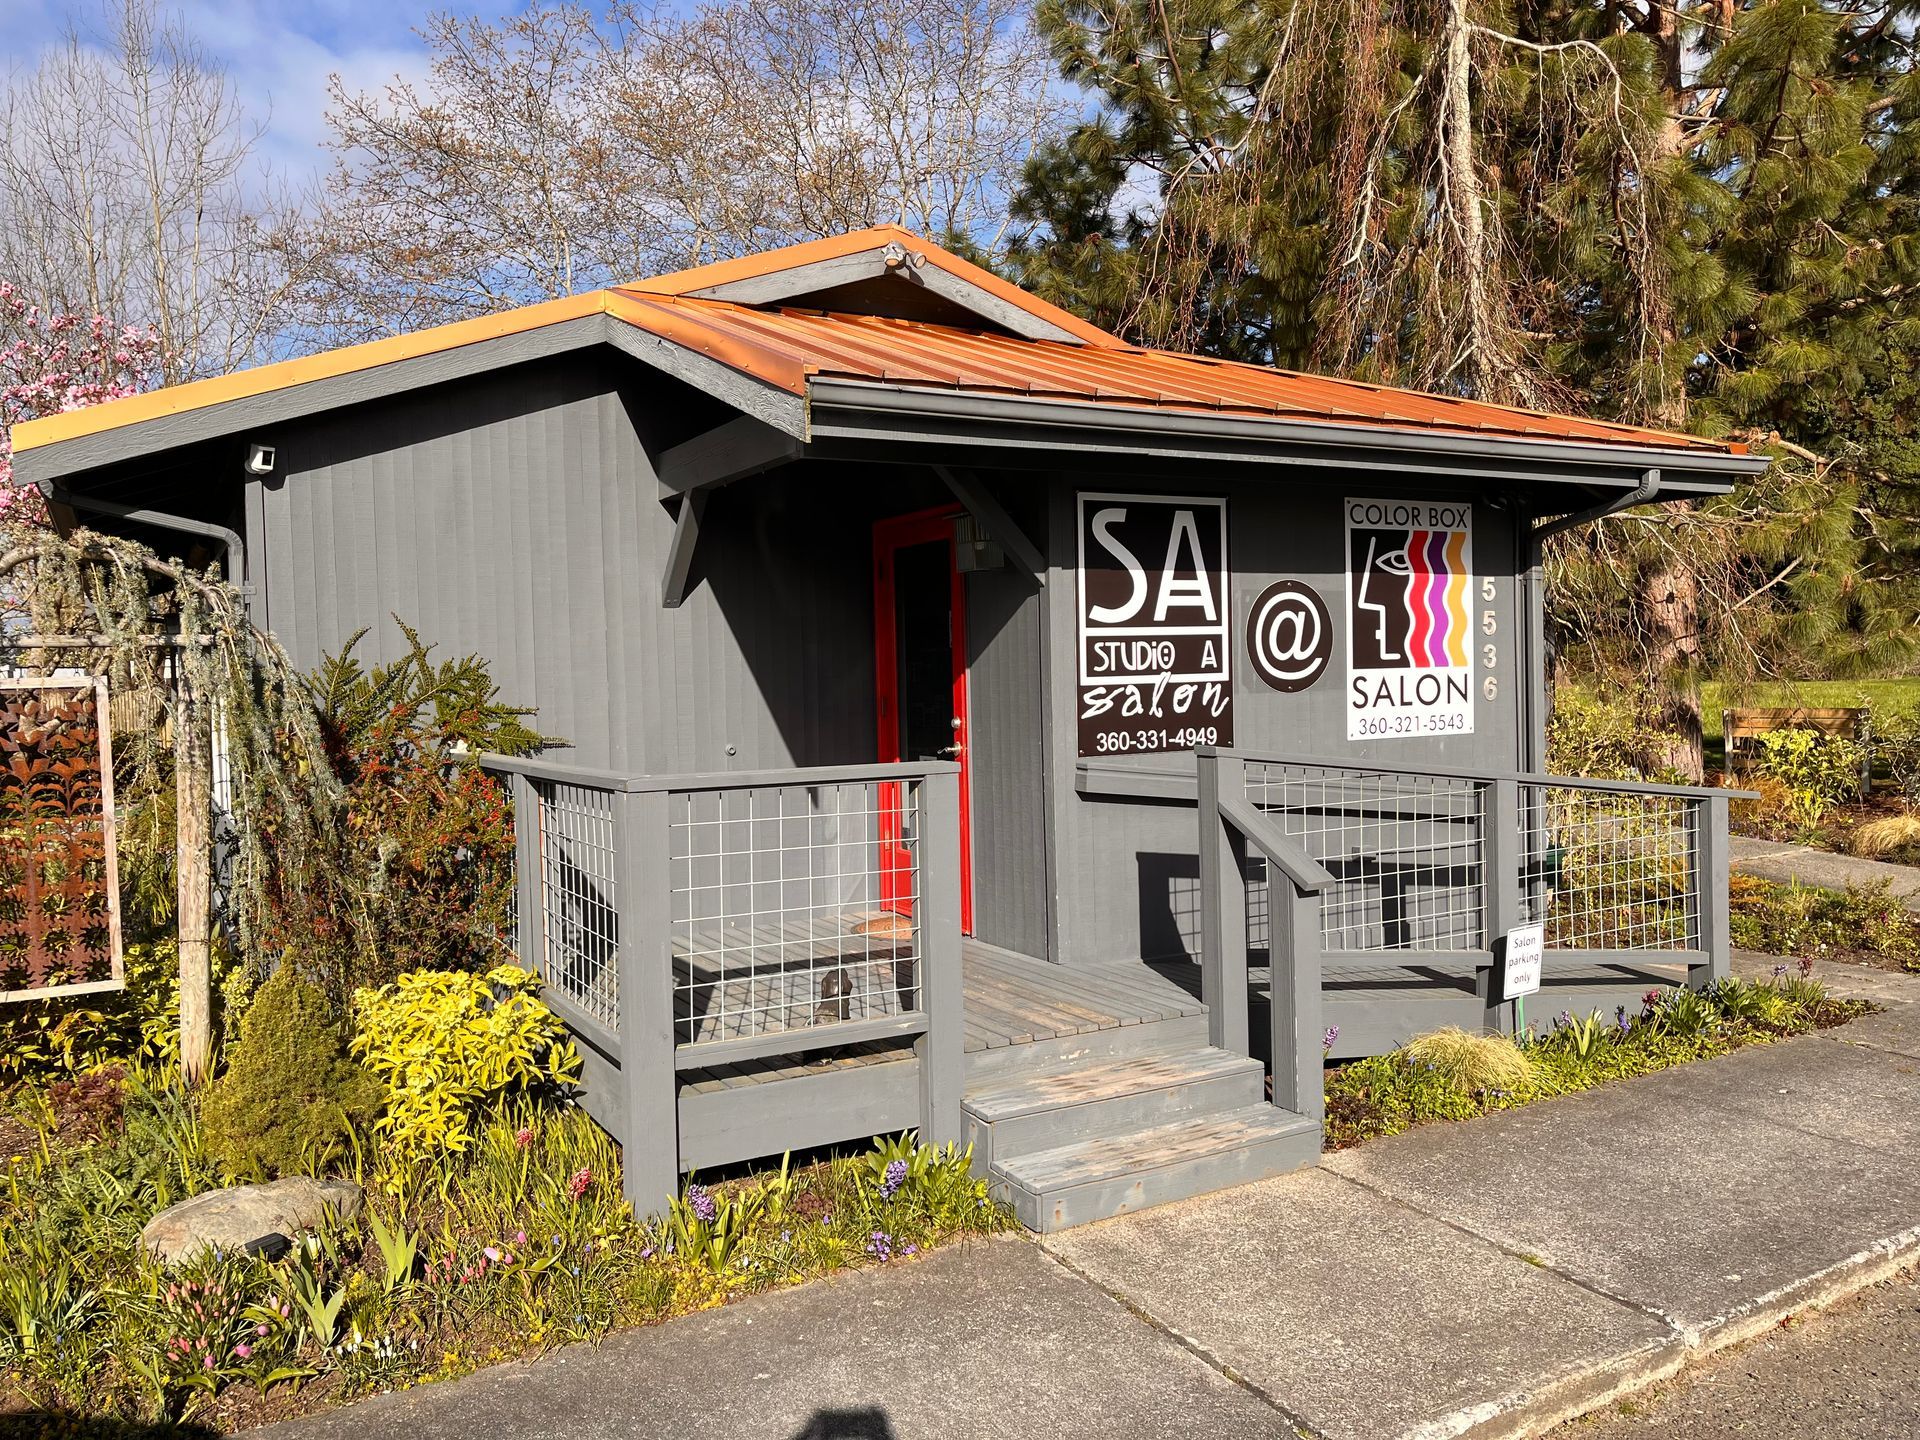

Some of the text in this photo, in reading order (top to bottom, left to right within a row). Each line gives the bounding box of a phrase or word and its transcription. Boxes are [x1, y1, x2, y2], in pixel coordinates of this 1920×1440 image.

[1350, 503, 1467, 528] COLOR BOX
[1256, 592, 1322, 680] @
[1201, 640, 1217, 668] A
[1081, 671, 1229, 719] salon
[1352, 673, 1468, 709] SALON
[1359, 714, 1464, 735] 360-321-5543
[1096, 727, 1217, 752] 360-331-4949
[1513, 936, 1536, 949] Salon
[1508, 953, 1539, 970] parking
[1513, 972, 1532, 984] only
